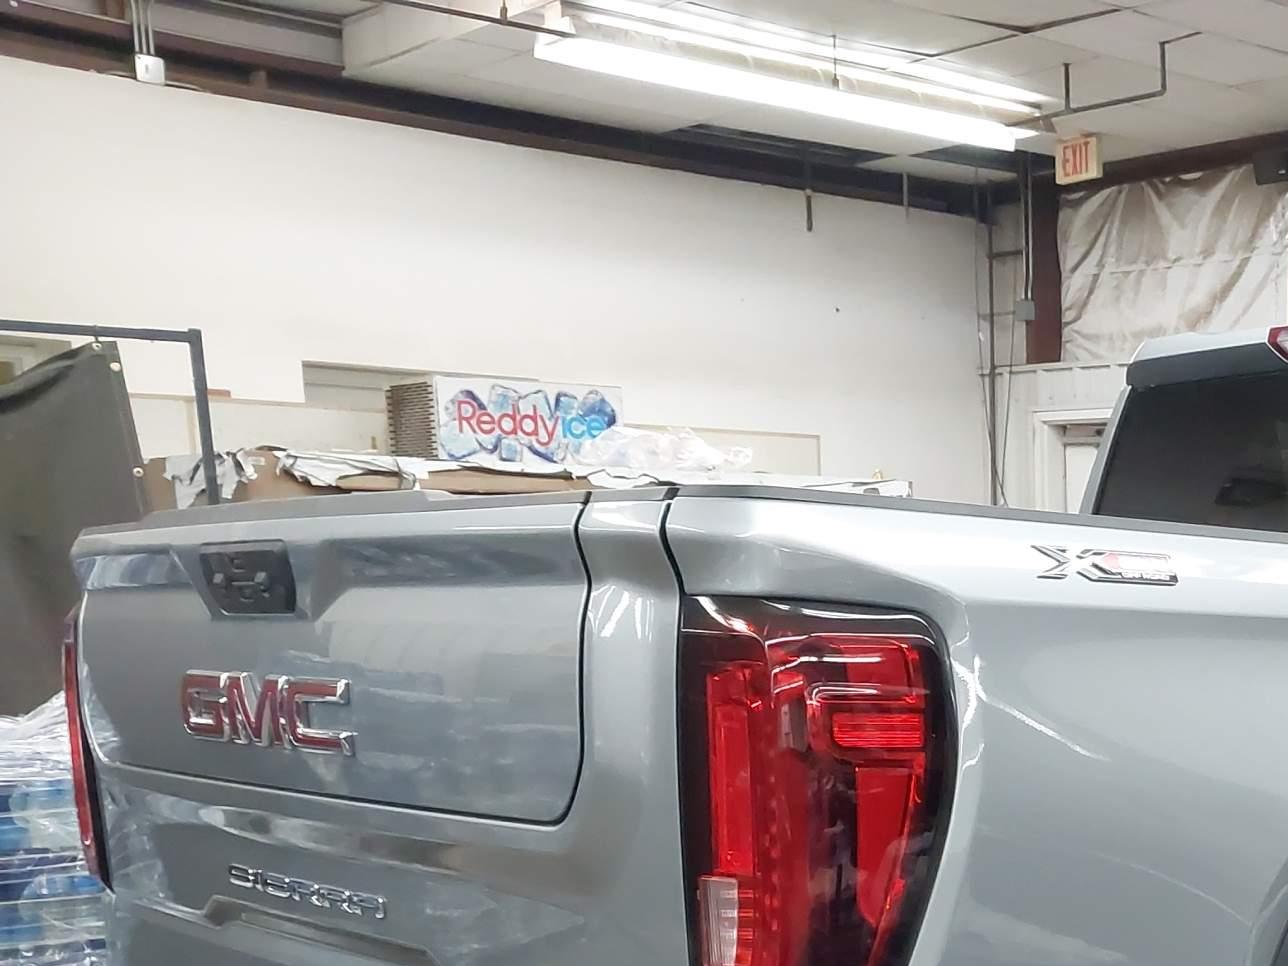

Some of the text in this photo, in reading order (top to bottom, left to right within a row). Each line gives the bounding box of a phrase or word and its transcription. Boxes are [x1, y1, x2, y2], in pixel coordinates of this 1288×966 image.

[1062, 141, 1090, 178] EXIT
[182, 669, 358, 757] GMC
[229, 863, 387, 919] SIERRA
